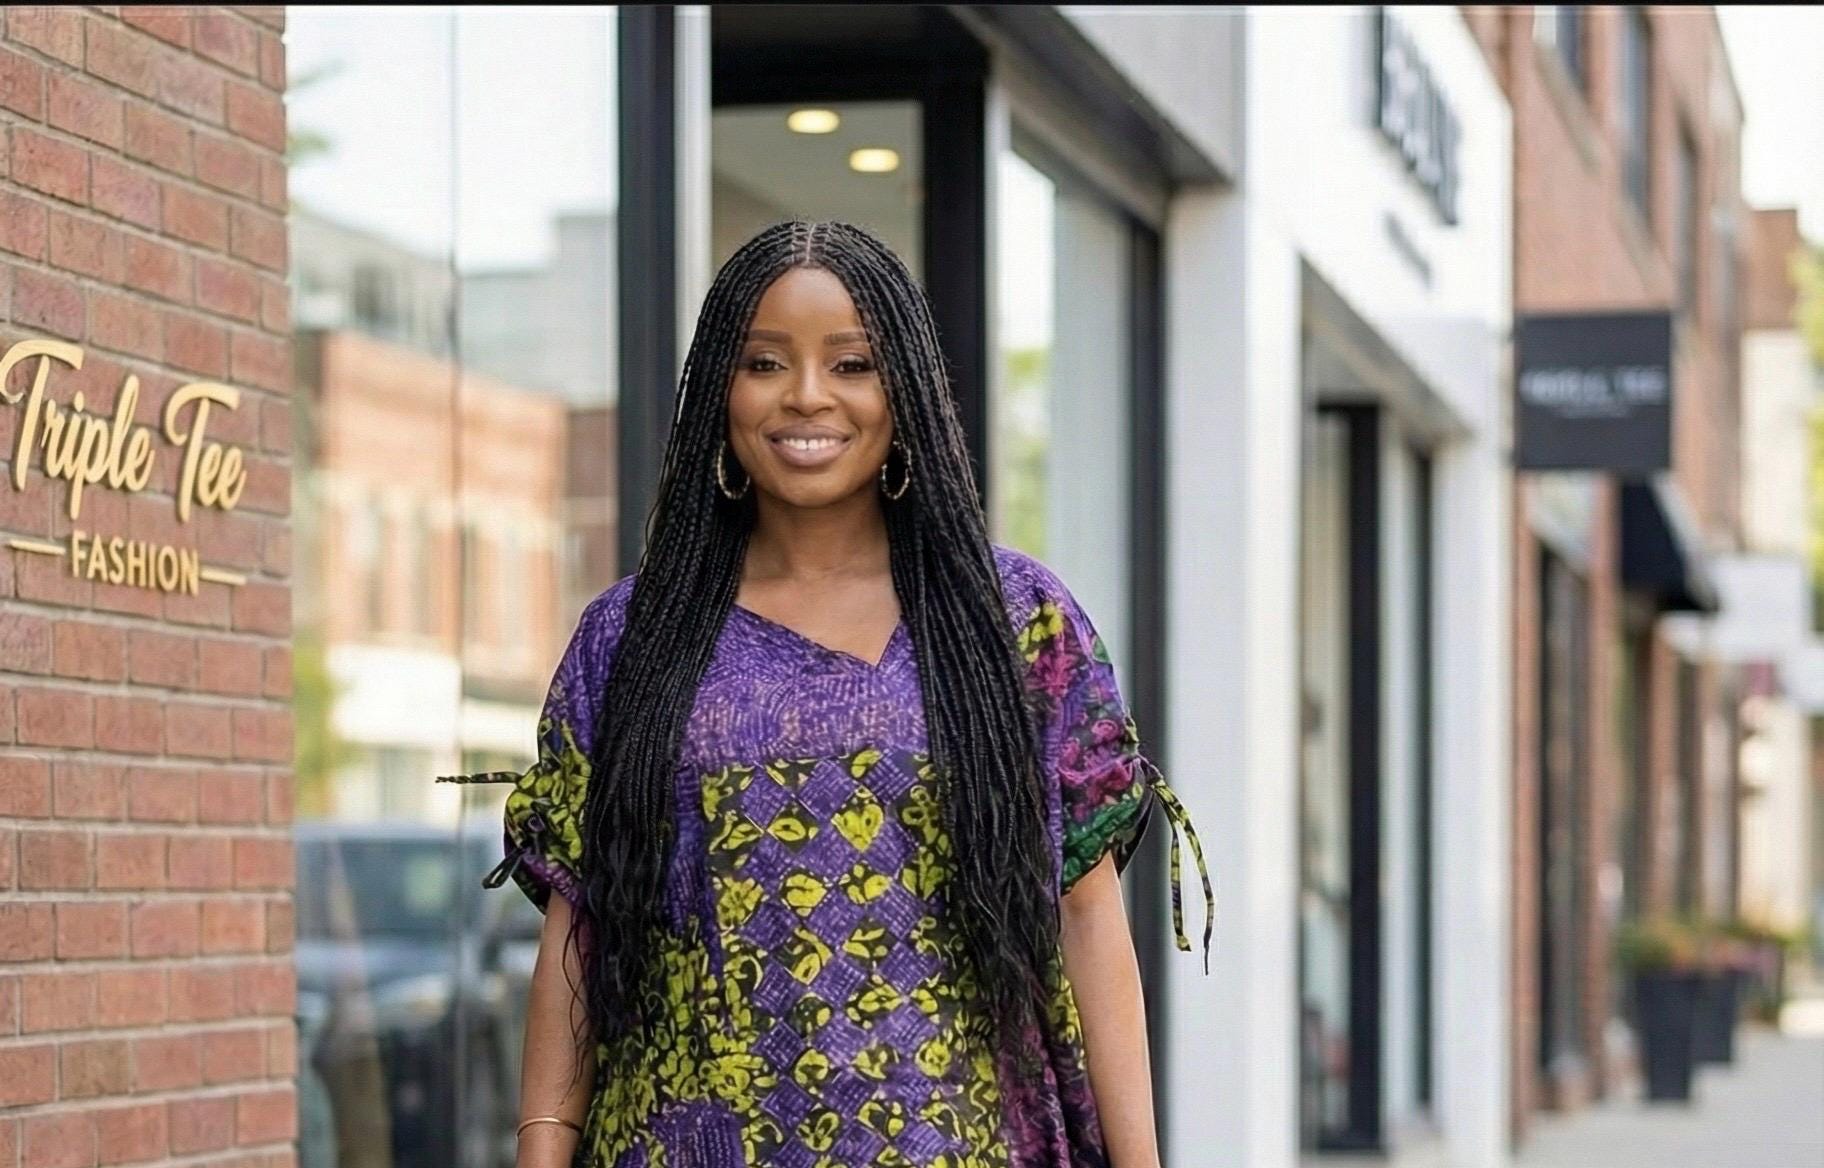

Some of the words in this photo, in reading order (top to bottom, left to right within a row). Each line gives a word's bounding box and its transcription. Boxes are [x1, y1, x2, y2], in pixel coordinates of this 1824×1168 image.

[0, 339, 154, 521] Triple
[164, 382, 247, 522] Tee
[71, 530, 200, 596] FASHION
